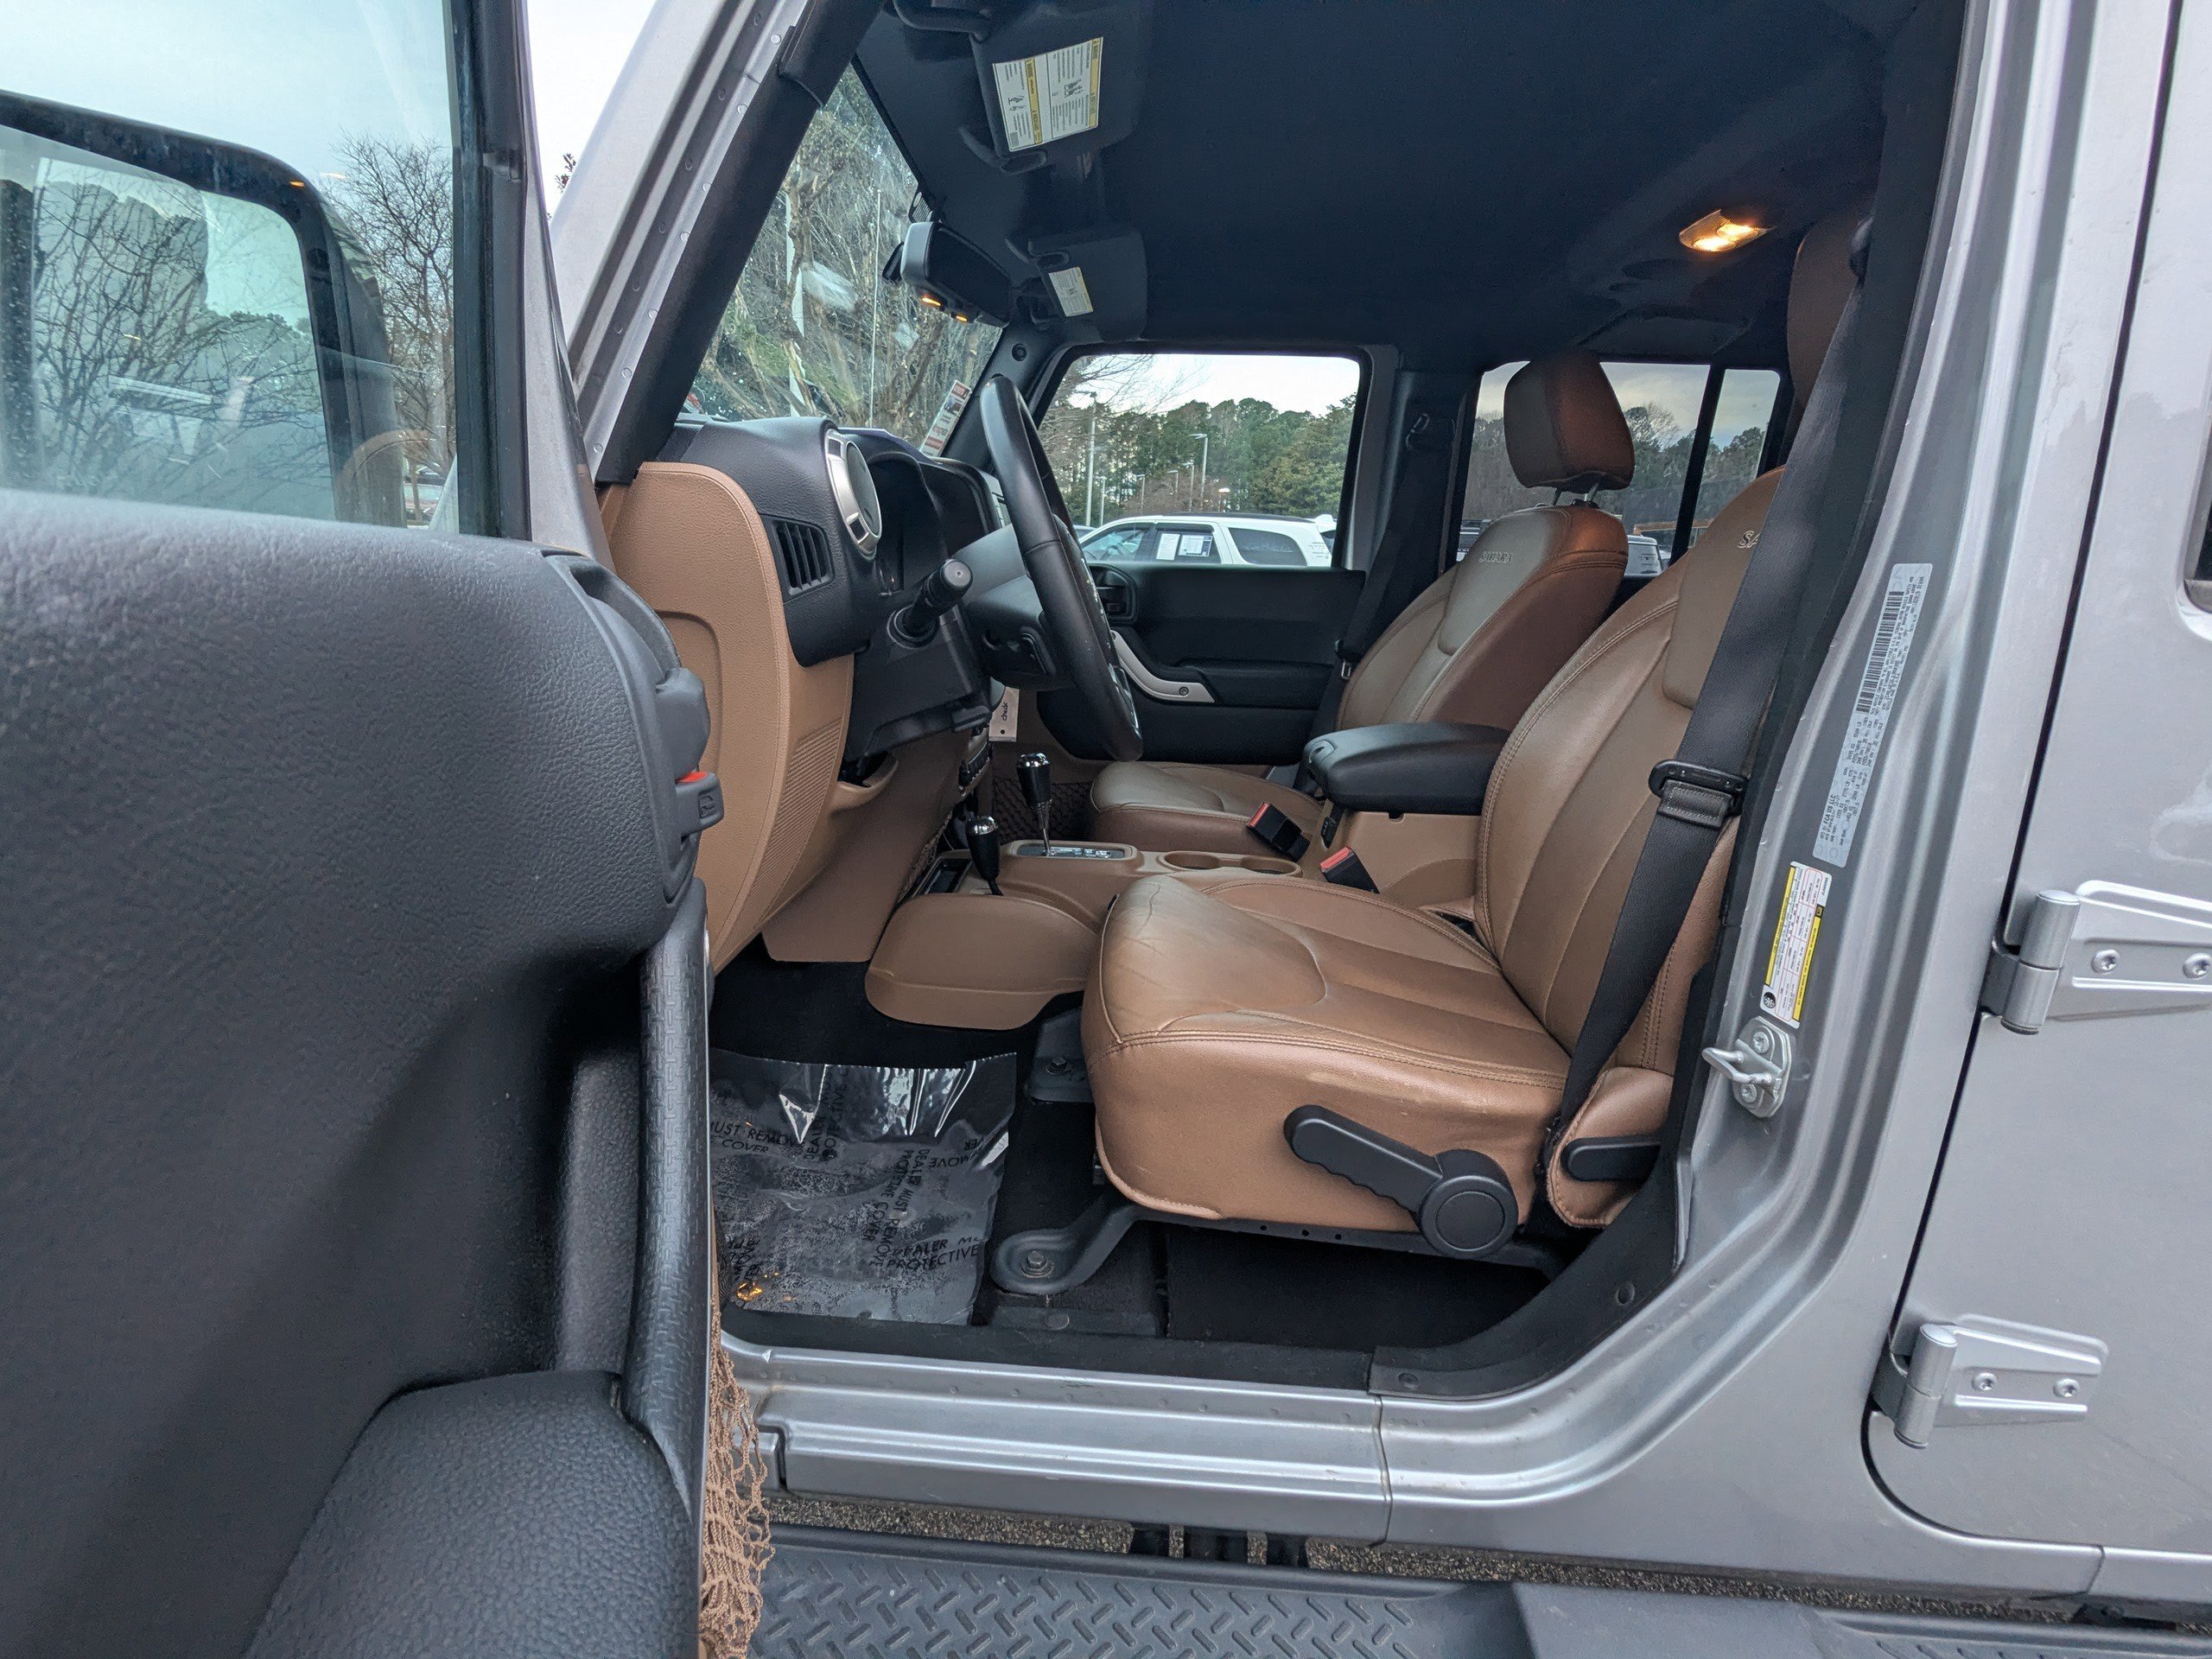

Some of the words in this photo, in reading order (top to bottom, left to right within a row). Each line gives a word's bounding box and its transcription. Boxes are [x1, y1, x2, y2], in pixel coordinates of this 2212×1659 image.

[1826, 804, 1833, 813] US
[893, 1188, 914, 1211] MUST
[861, 1201, 888, 1242] COVER
[887, 1244, 979, 1270] PROTECTIVE
